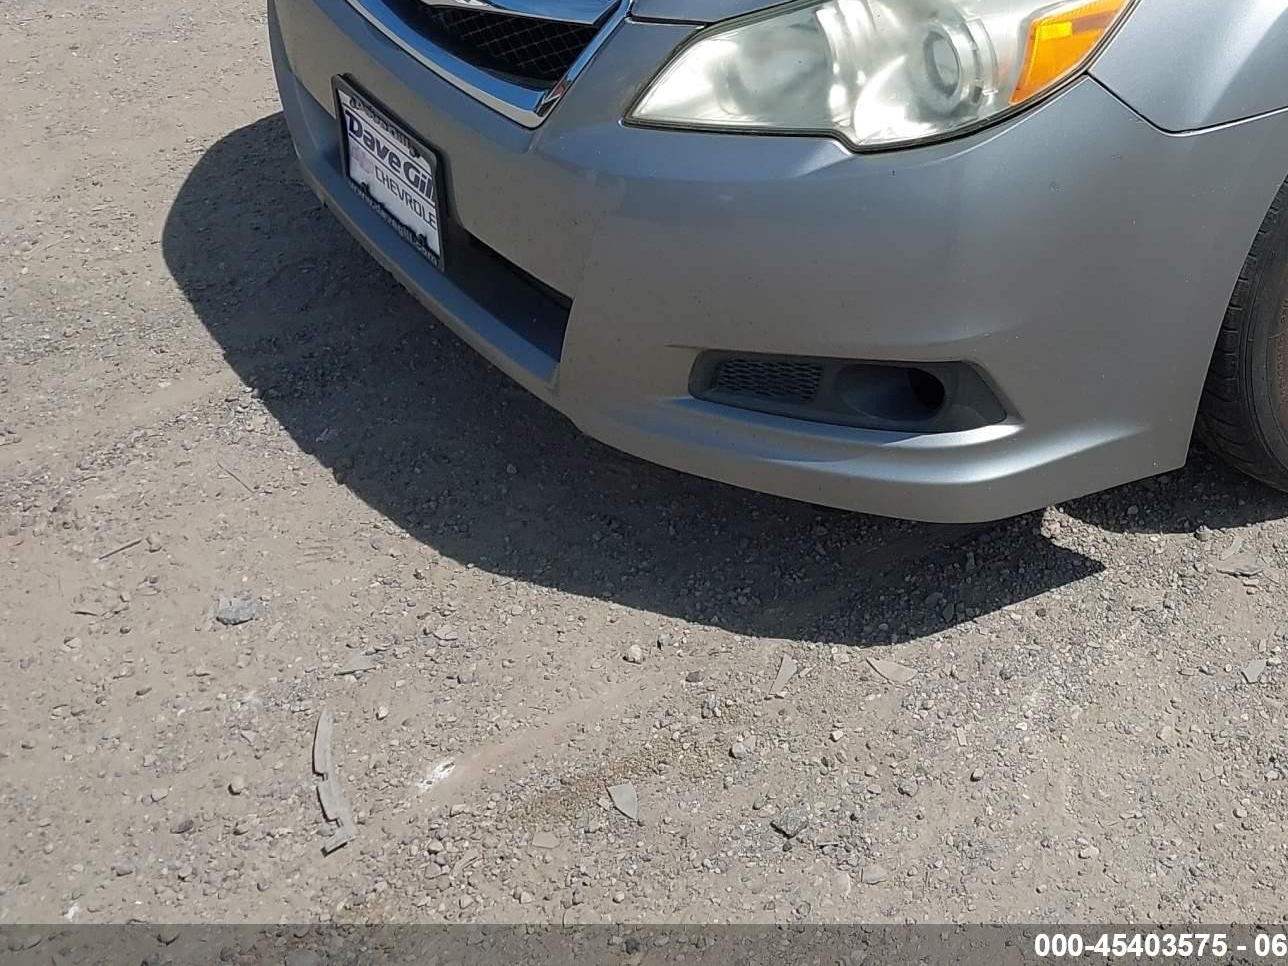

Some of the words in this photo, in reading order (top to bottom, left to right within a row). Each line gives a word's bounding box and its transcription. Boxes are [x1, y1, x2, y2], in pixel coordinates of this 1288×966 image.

[345, 110, 402, 174] Dave
[402, 157, 435, 202] Gil
[374, 164, 438, 231] CHEVROLE
